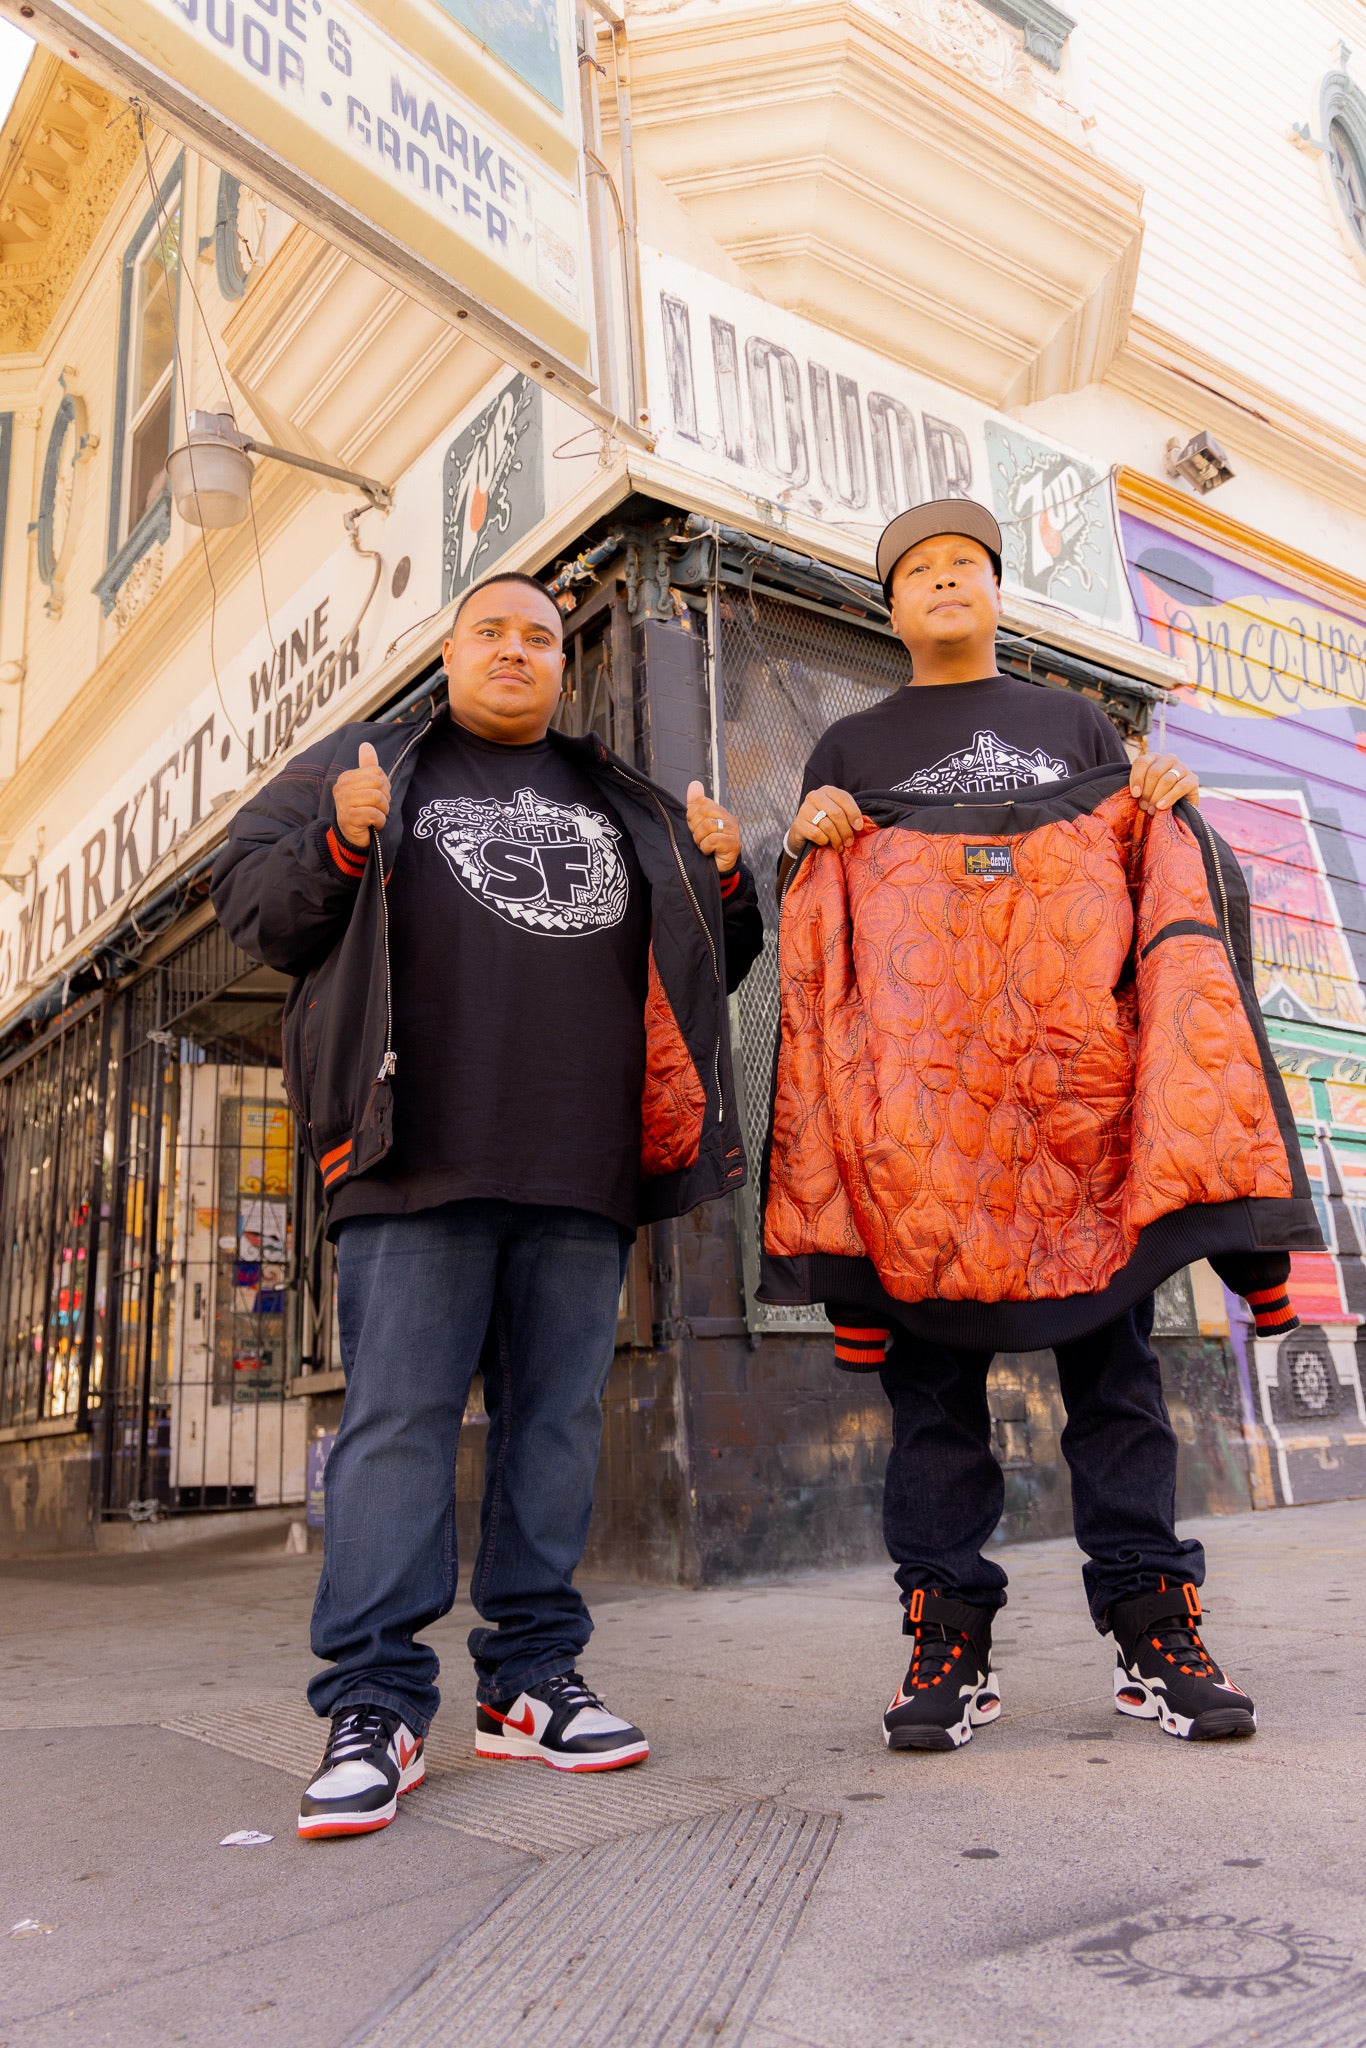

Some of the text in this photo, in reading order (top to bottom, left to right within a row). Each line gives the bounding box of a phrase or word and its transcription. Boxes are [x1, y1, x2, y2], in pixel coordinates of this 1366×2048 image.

[390, 74, 533, 222] MARKET
[660, 288, 973, 523] LIQUOR
[246, 627, 360, 775] LIQUOR
[250, 595, 330, 714] WINE
[17, 713, 215, 988] MARKET
[480, 837, 593, 907] SF
[488, 820, 580, 843] ALL-IN
[990, 851, 1010, 872] derby
[1072, 1954, 1169, 1987] ME
[1177, 1972, 1317, 1999] FOR
